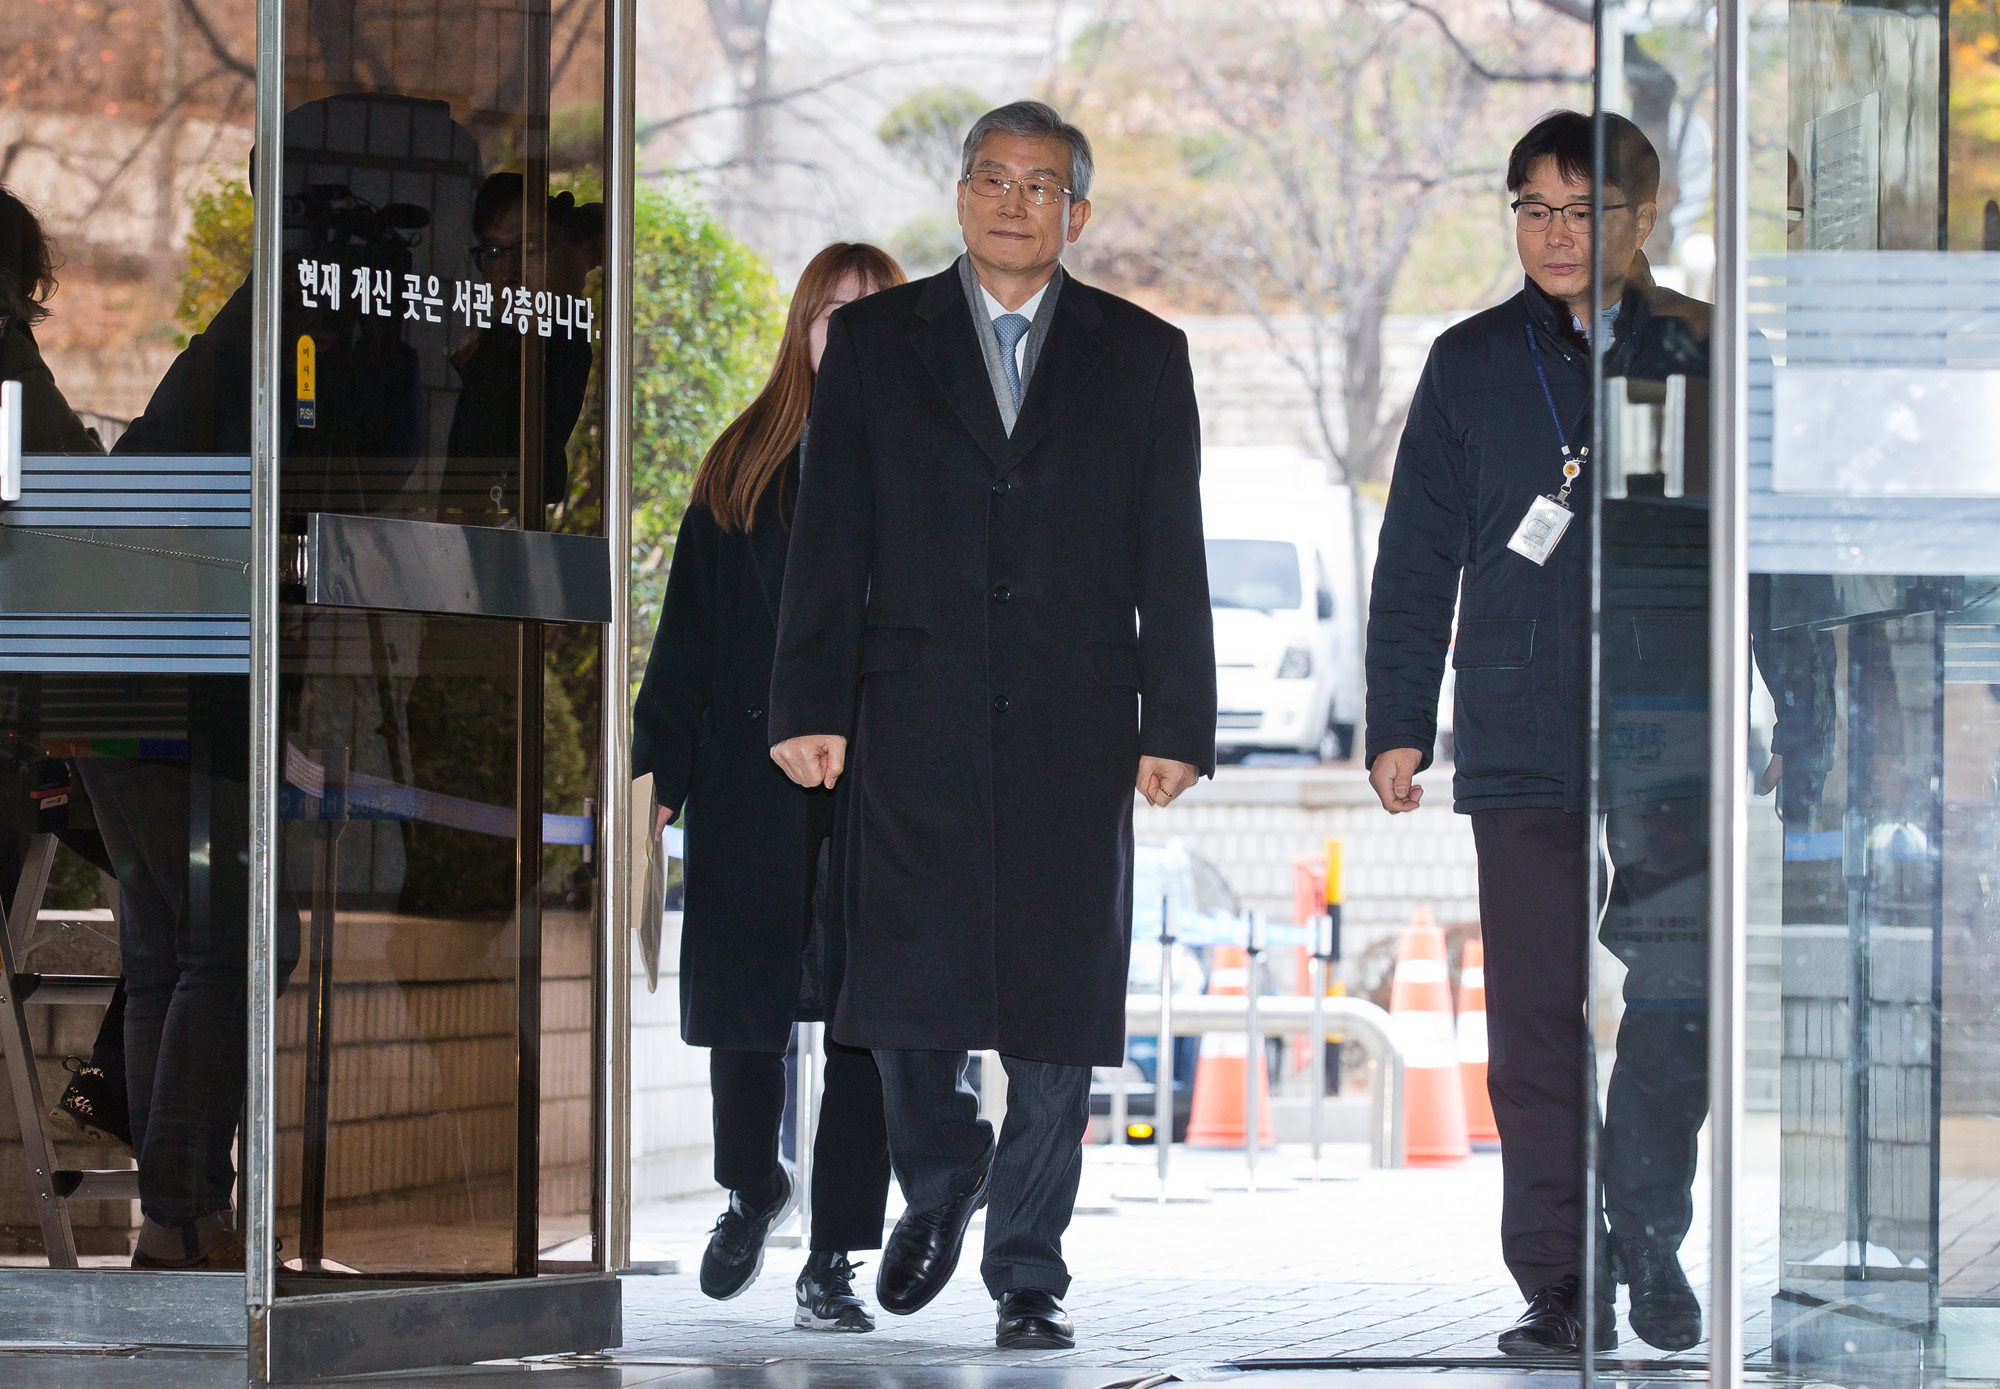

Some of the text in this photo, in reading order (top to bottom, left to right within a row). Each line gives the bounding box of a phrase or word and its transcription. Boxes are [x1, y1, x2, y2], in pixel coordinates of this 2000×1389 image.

[298, 258, 601, 343] 현재 계신 곳은 서관 2층입니다.
[302, 346, 311, 392] 미시오
[299, 407, 314, 420] PUSH
